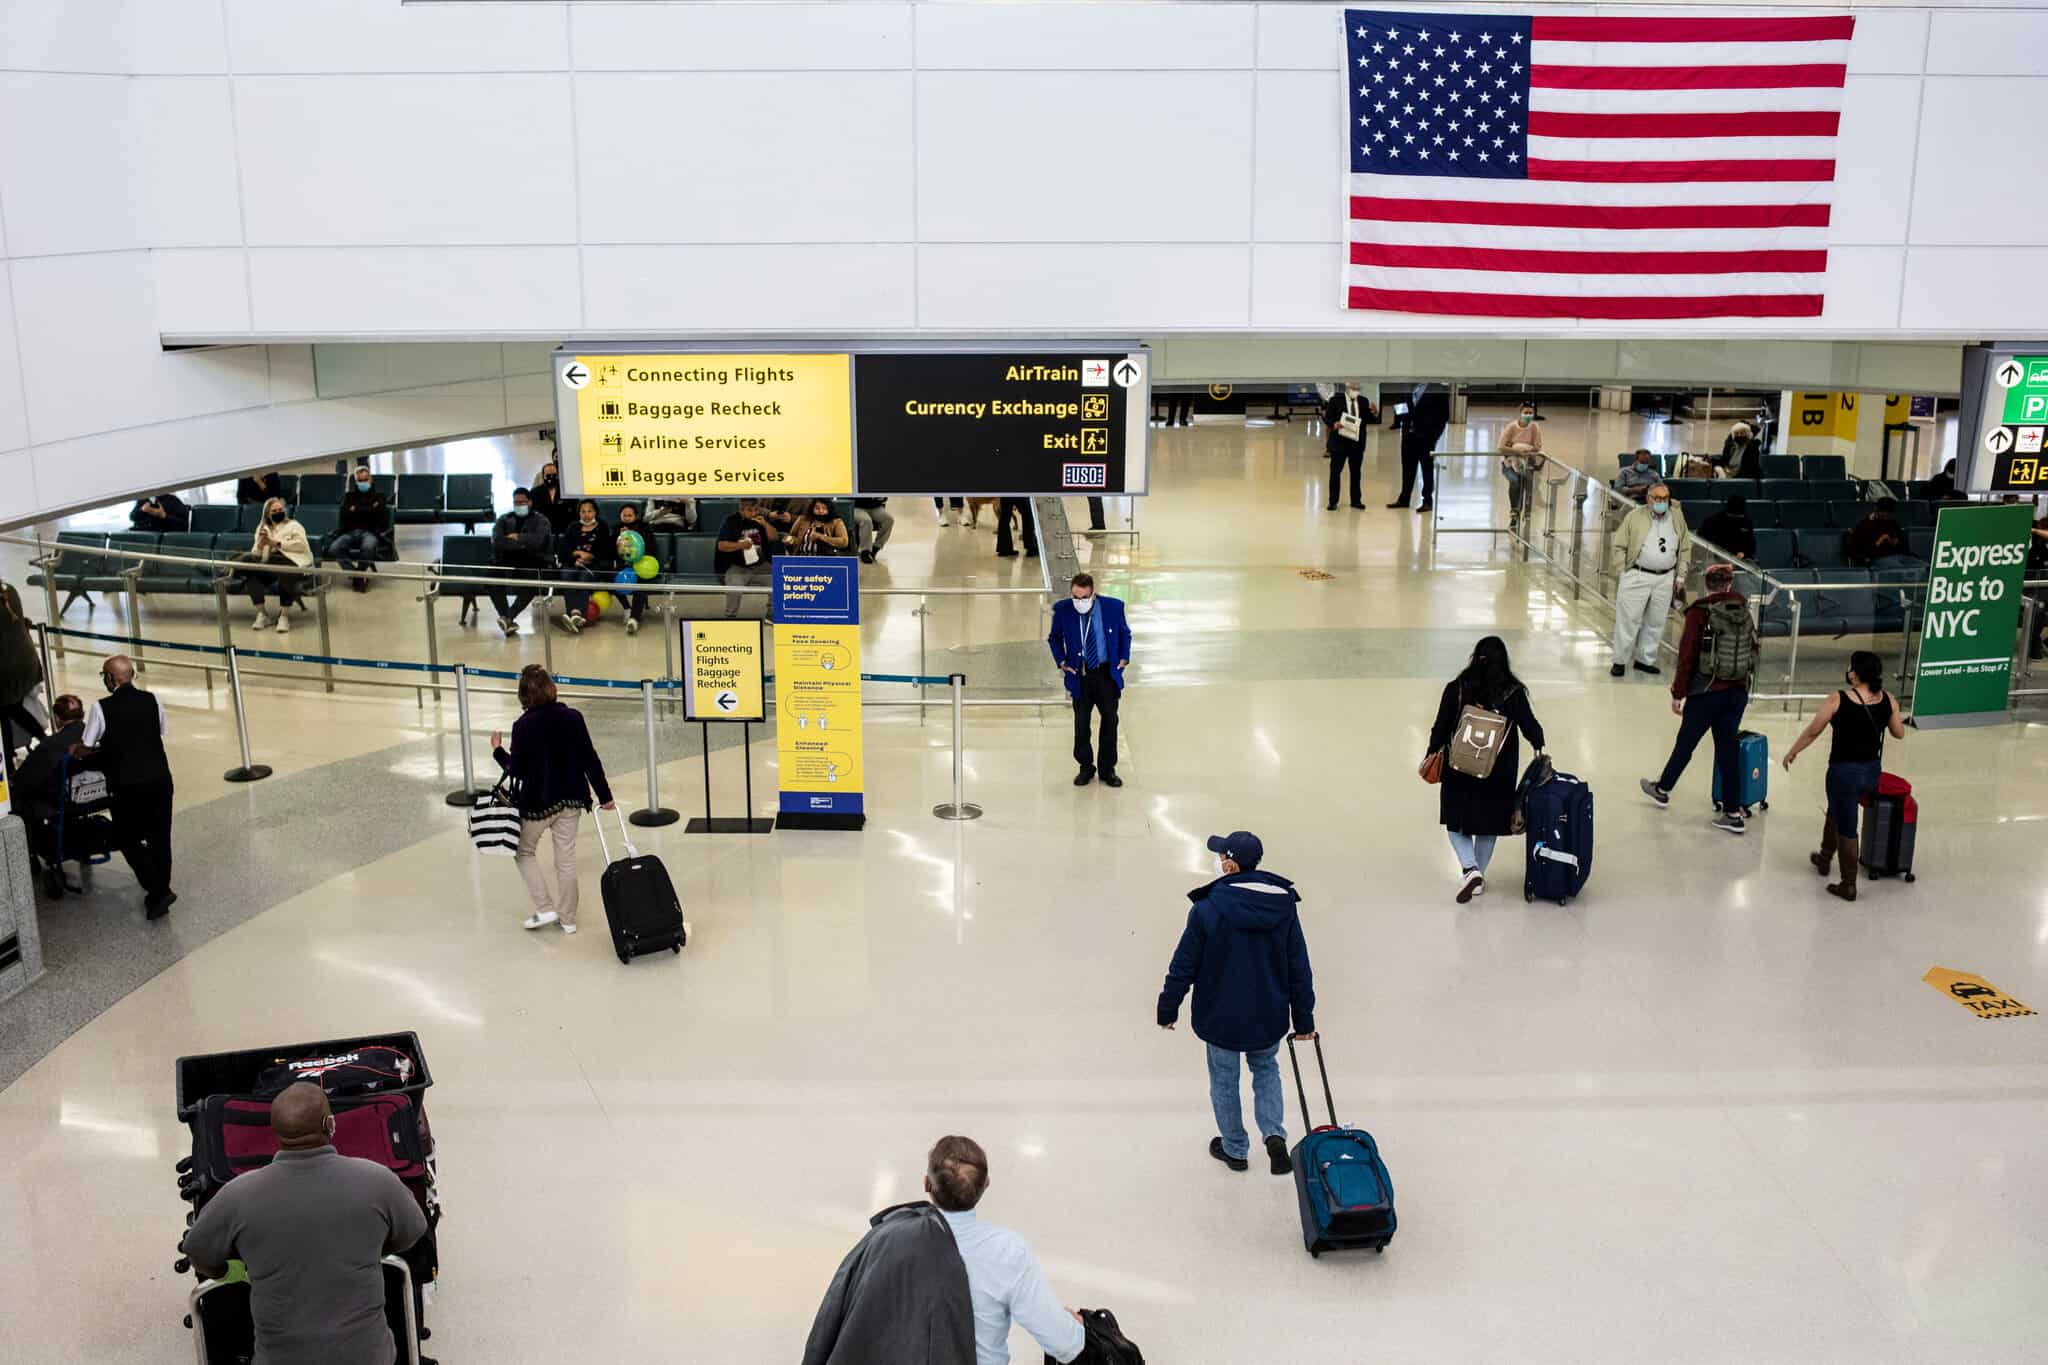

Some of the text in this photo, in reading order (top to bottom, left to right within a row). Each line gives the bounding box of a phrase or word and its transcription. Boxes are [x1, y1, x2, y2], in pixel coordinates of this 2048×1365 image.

[627, 367, 794, 385] Connecting Flights
[1005, 366, 1079, 381] AirTrain
[628, 401, 782, 419] Baggage Recheck
[905, 400, 1079, 419] Currency Exchange
[2026, 397, 2045, 418] P
[630, 435, 766, 449] Airline Services
[1043, 434, 1078, 449] Exit
[632, 468, 785, 486] Baggage Services
[1071, 467, 1098, 484] USO
[1935, 540, 2025, 575] Express
[783, 575, 833, 584] Your safety
[783, 583, 792, 591] is
[809, 584, 825, 592] top
[1930, 575, 2004, 604] Bus to
[783, 592, 816, 602] priority
[1925, 609, 1981, 639] NYC
[696, 644, 753, 656] Connecting
[696, 655, 729, 667] Flights
[697, 667, 741, 679] Baggage
[1920, 668, 1943, 677] Lower
[1943, 666, 1962, 675] Level
[1966, 665, 1980, 674] Bus
[1980, 664, 1997, 673] Stop
[697, 679, 738, 689] Recheck
[1962, 998, 2023, 1011] TAXI
[288, 1053, 360, 1071] Reebok
